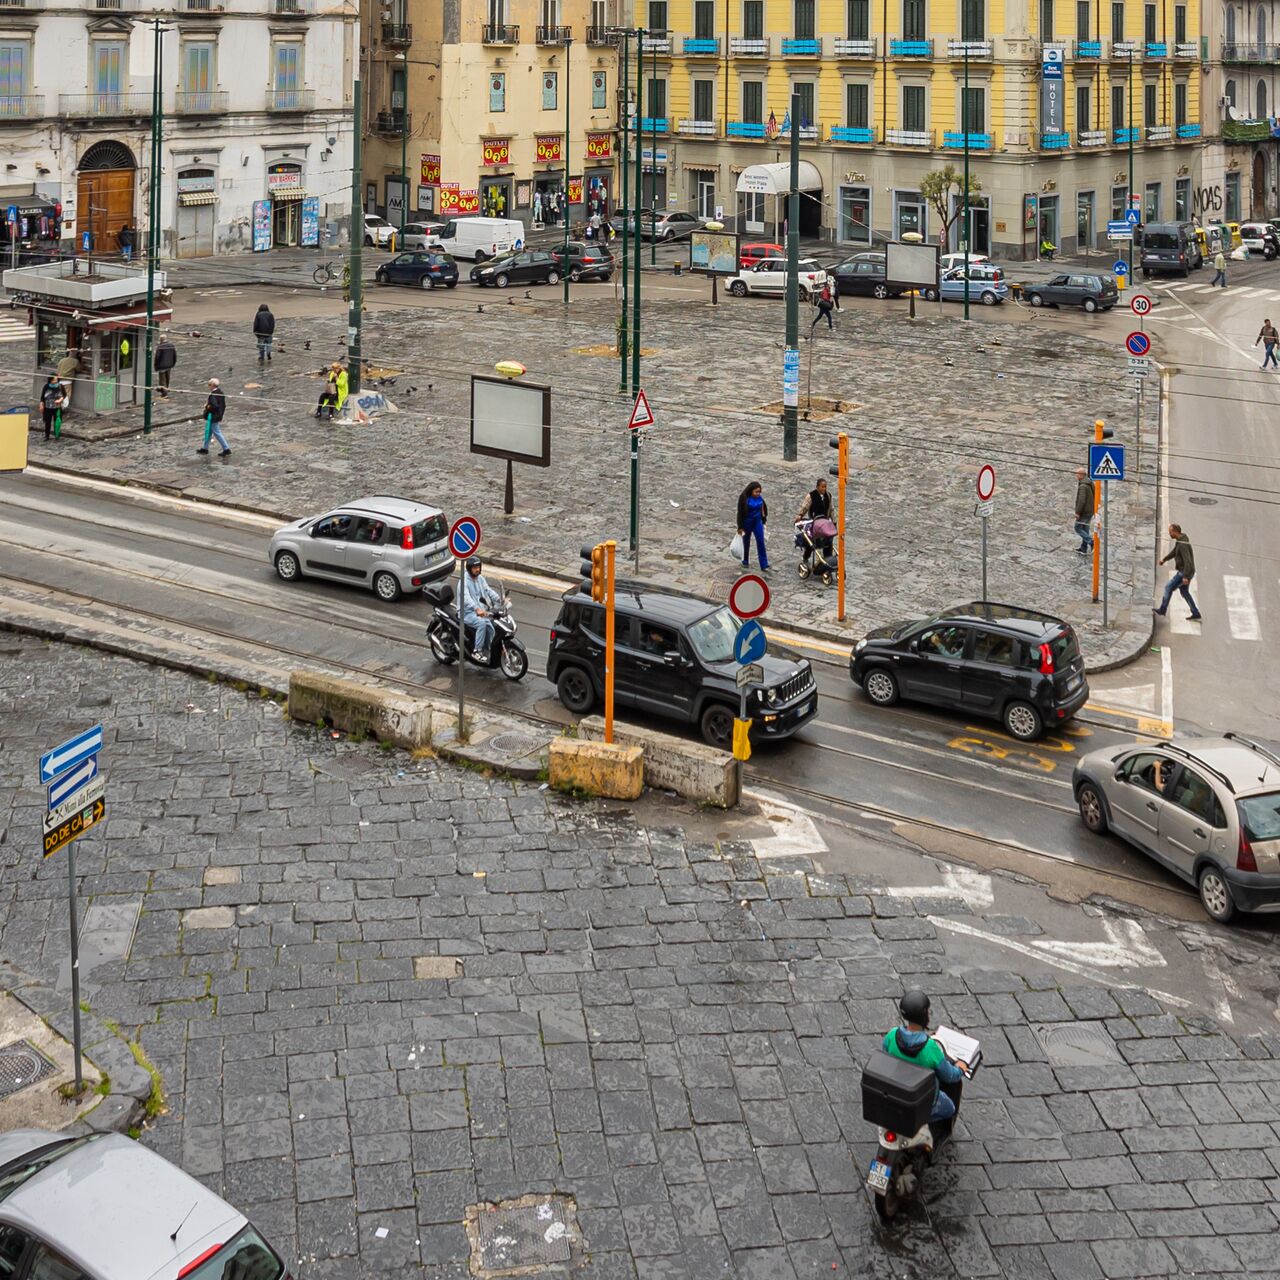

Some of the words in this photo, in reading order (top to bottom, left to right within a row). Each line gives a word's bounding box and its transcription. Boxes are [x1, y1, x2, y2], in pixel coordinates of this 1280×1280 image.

[1193, 185, 1223, 214] MOAS
[1136, 300, 1147, 310] 30
[45, 833, 58, 850] DO
[60, 826, 70, 841] DE
